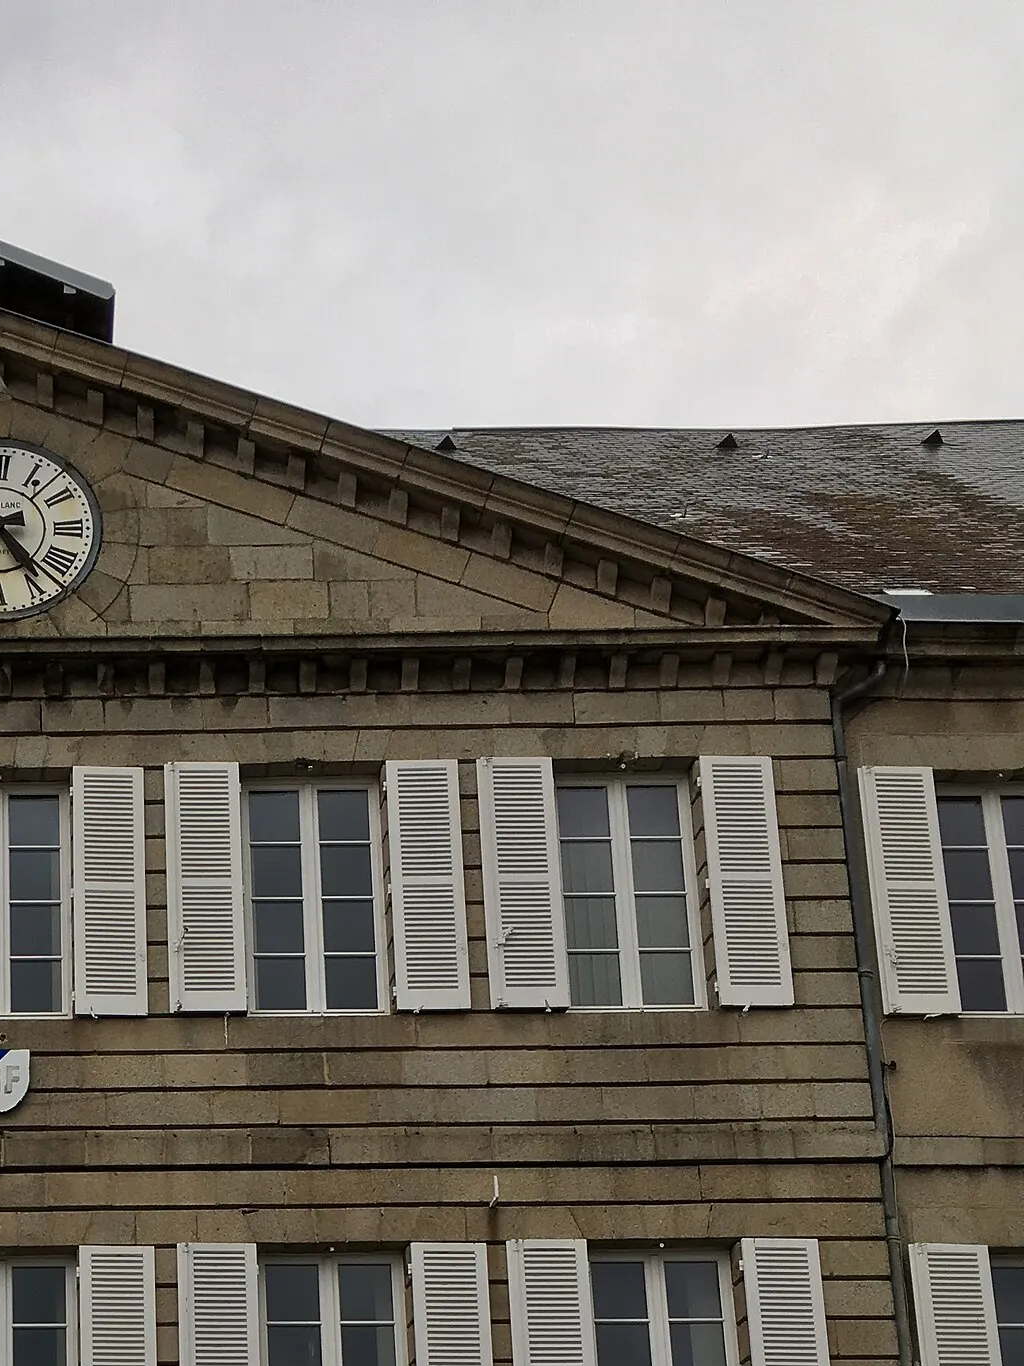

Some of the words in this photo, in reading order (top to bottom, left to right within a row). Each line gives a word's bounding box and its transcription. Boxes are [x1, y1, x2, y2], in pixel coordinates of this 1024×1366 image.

[43, 485, 75, 509] II
[52, 518, 83, 539] III
[24, 573, 47, 600] V
